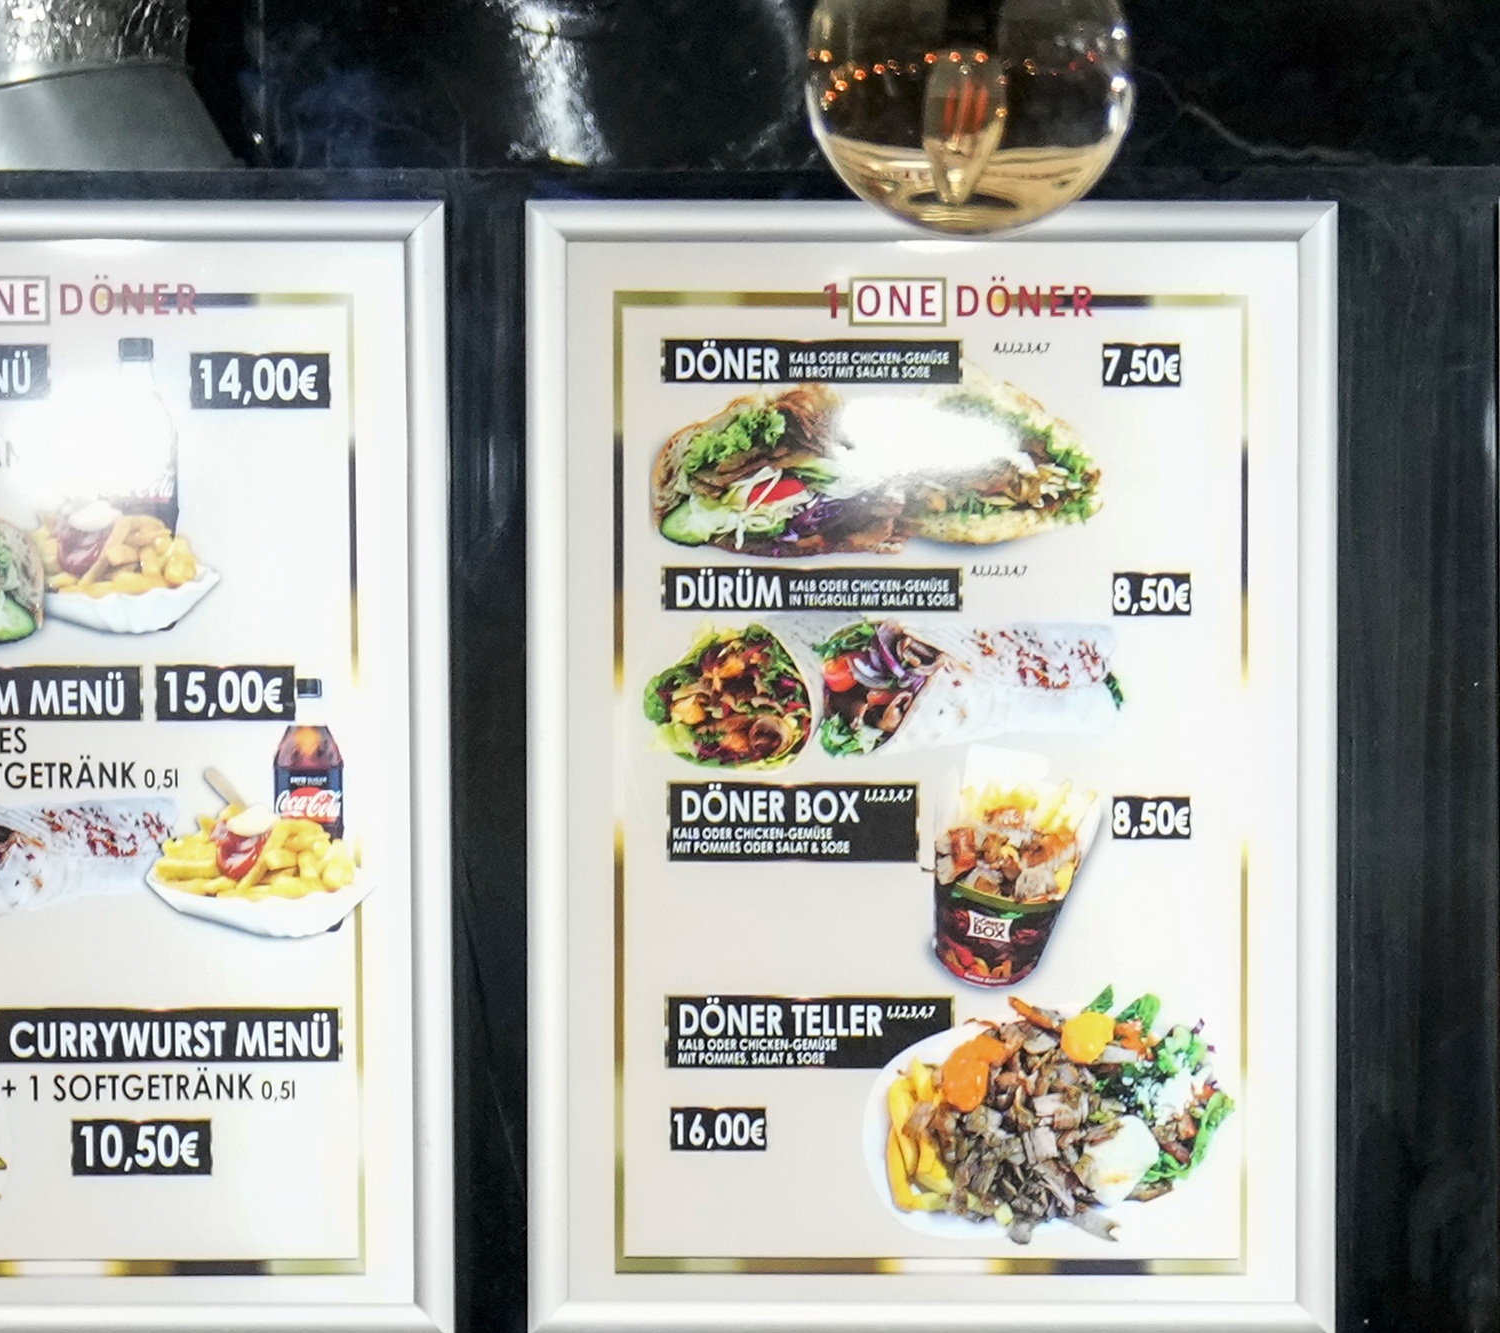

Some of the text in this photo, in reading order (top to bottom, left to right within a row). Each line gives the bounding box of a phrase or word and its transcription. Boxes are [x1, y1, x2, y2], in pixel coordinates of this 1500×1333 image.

[60, 275, 196, 319] DÖNER
[858, 276, 1093, 320] ONE DÖNER
[676, 341, 779, 380] DÖNER
[789, 352, 816, 364] KALB
[819, 352, 849, 364] ODER
[1105, 349, 1179, 385] 7,50€
[199, 360, 318, 405] 14,00€
[676, 570, 783, 609] DÜRÜM
[1114, 578, 1189, 613] 8,50€
[30, 672, 124, 715] MENÜ
[164, 673, 283, 715] 15,00€
[682, 784, 859, 823] DÖNER BOX
[1114, 802, 1189, 836] 8,50€
[10, 1013, 330, 1057] CURRYWURST MENÜ
[679, 998, 883, 1036] DÖNER TELLER
[54, 1067, 252, 1101] SOFTGETRÄNK
[81, 1126, 199, 1171] 10,50€
[674, 1113, 764, 1148] 16,00€
